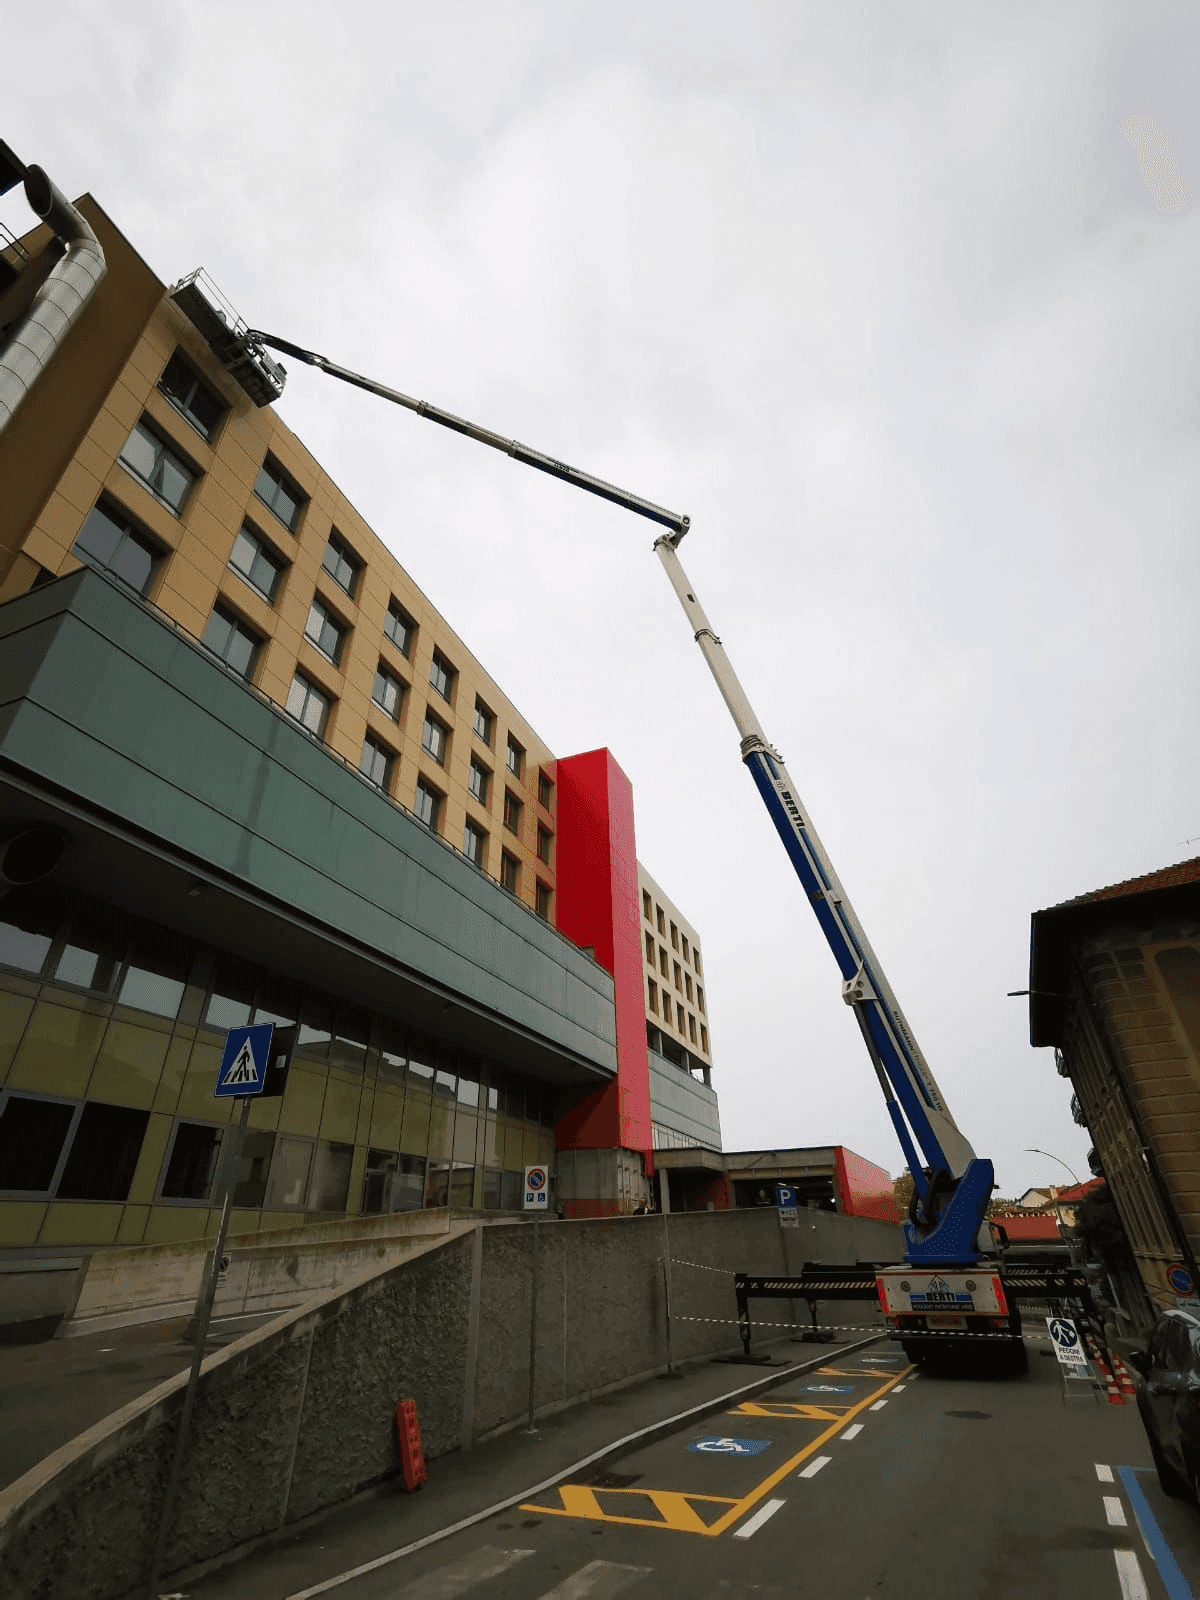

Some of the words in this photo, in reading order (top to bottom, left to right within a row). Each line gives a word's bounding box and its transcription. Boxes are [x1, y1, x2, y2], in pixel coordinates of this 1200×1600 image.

[781, 791, 805, 827] BERTI
[892, 1011, 915, 1051] RUTHMANN
[780, 1189, 791, 1205] P
[926, 1292, 955, 1302] BERTI
